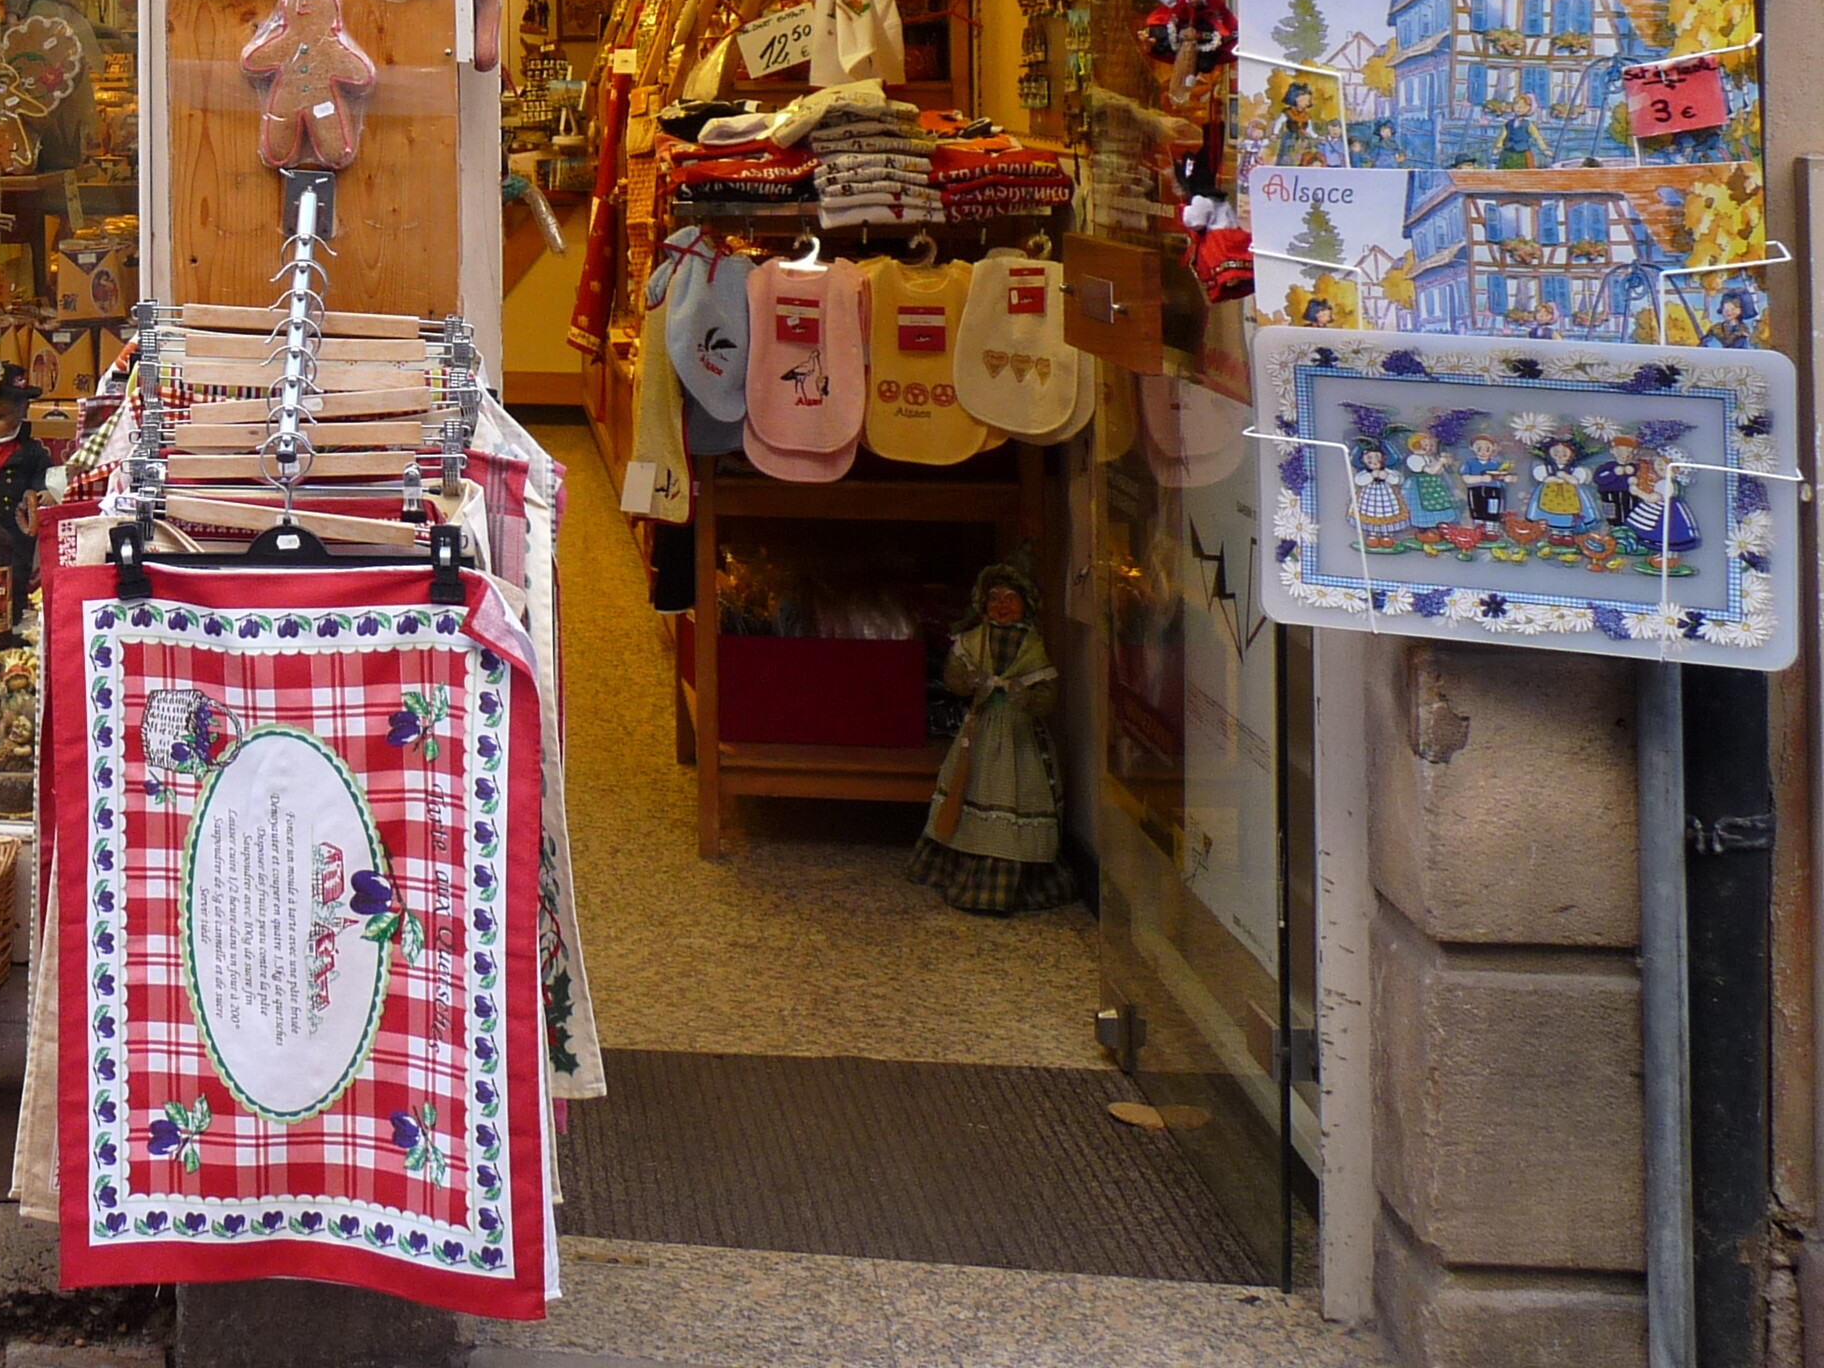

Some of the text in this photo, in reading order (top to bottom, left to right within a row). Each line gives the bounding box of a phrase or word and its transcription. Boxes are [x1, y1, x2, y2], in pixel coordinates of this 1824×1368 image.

[1651, 99, 1697, 122] 3 €
[1261, 173, 1354, 205] Alsace
[426, 783, 455, 1053] Tarte aux Quetsches
